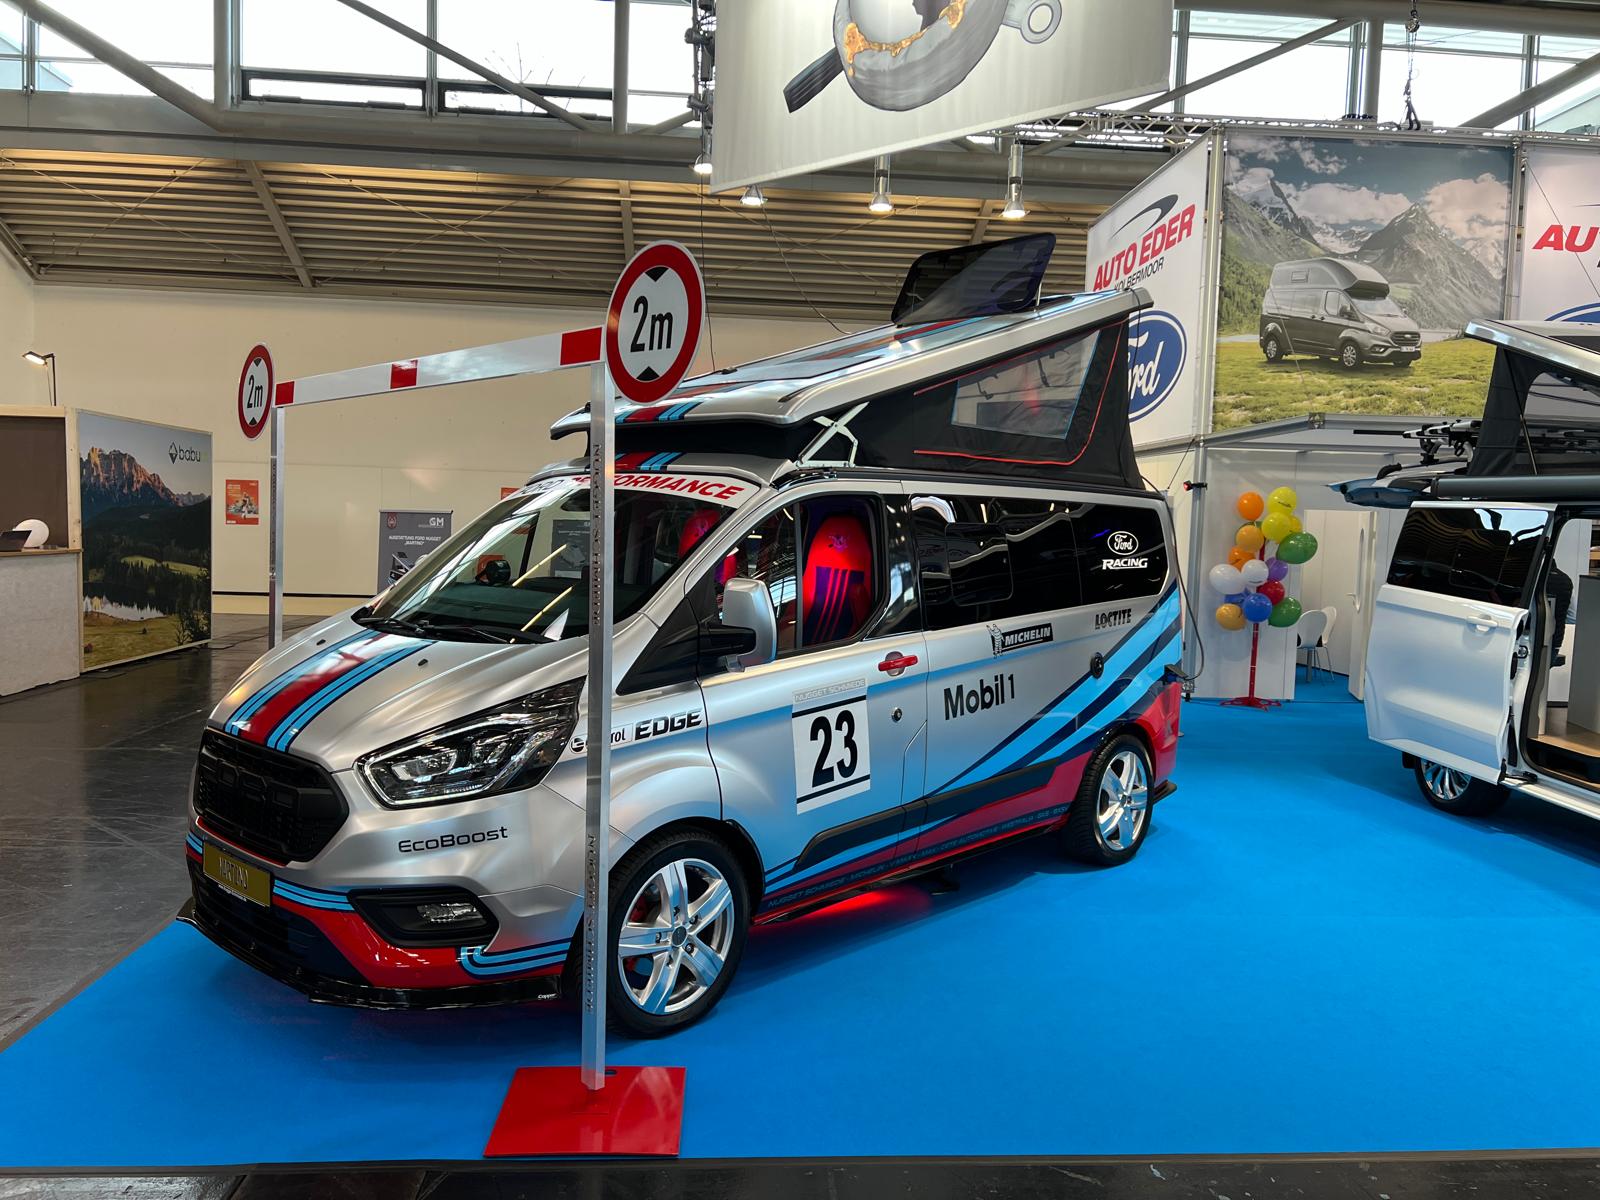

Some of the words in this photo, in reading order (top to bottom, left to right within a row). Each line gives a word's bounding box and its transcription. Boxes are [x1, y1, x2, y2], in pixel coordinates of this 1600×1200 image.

[1093, 242, 1137, 291] AUTO
[1139, 203, 1195, 267] EDER
[1532, 224, 1600, 252] AU
[630, 295, 674, 353] 2m
[1127, 331, 1165, 400] rd
[246, 374, 264, 409] 2m
[178, 444, 201, 463] babu
[429, 516, 445, 528] GM
[1113, 534, 1134, 551] Ford
[1102, 557, 1149, 570] RACING
[1095, 608, 1132, 630] LOCTITE
[1004, 626, 1051, 647] MICHELIN
[795, 688, 828, 702] NUGGET
[943, 673, 1005, 721] Mobil
[1007, 674, 1016, 700] 1
[635, 709, 703, 741] EDGE
[810, 709, 859, 788] 23
[398, 826, 509, 853] EcoBoost
